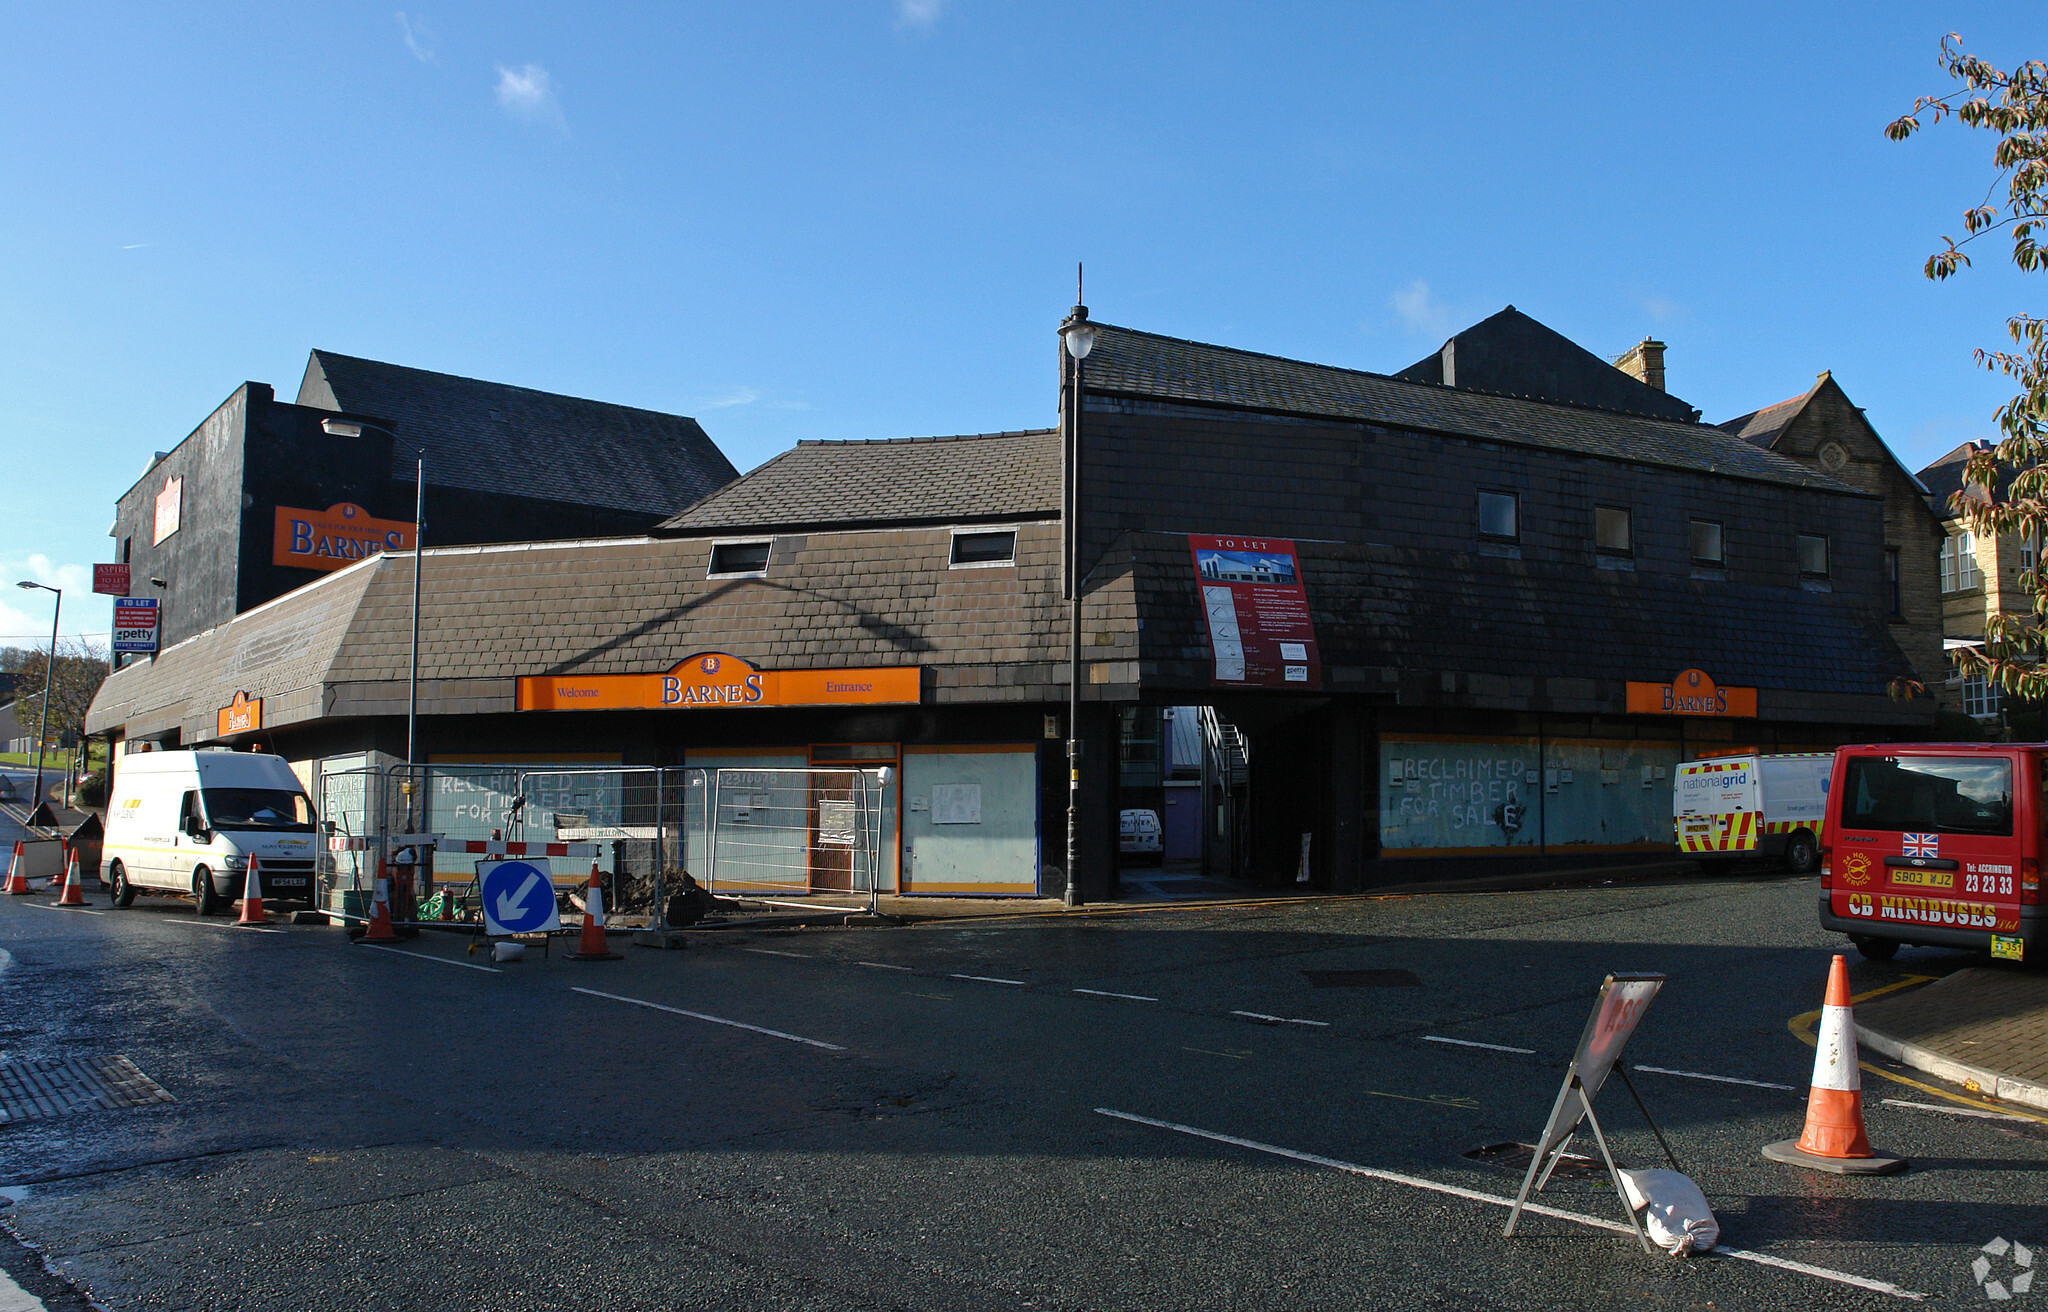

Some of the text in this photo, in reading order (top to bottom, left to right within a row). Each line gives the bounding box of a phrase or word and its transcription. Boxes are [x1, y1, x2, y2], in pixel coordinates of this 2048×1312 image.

[1216, 539, 1267, 550] TO LET
[98, 565, 129, 574] ASPIRE
[123, 599, 150, 607] TO LET
[122, 629, 154, 641] petty
[705, 658, 716, 670] B
[557, 686, 600, 699] Welcome
[660, 674, 764, 705] BARNES
[826, 680, 873, 693] Entrance
[1661, 686, 1728, 714] BARNES
[1404, 757, 1525, 780] RECLAIMED
[1682, 771, 1747, 790] nationalgrid
[455, 803, 493, 824] FOR
[1400, 796, 1439, 818] FOR
[1452, 804, 1519, 829] SALE
[1842, 852, 1872, 867] 24 HOUR
[1966, 863, 2013, 875] Tel: ACCRINGTON
[1842, 872, 1872, 887] SERVICE
[1895, 871, 1952, 886] SB03 WJZ
[1965, 874, 2013, 895] 23 23 33
[1848, 893, 2019, 931] CB MINIBUSES Ltd
[2006, 942, 2022, 952] 351
